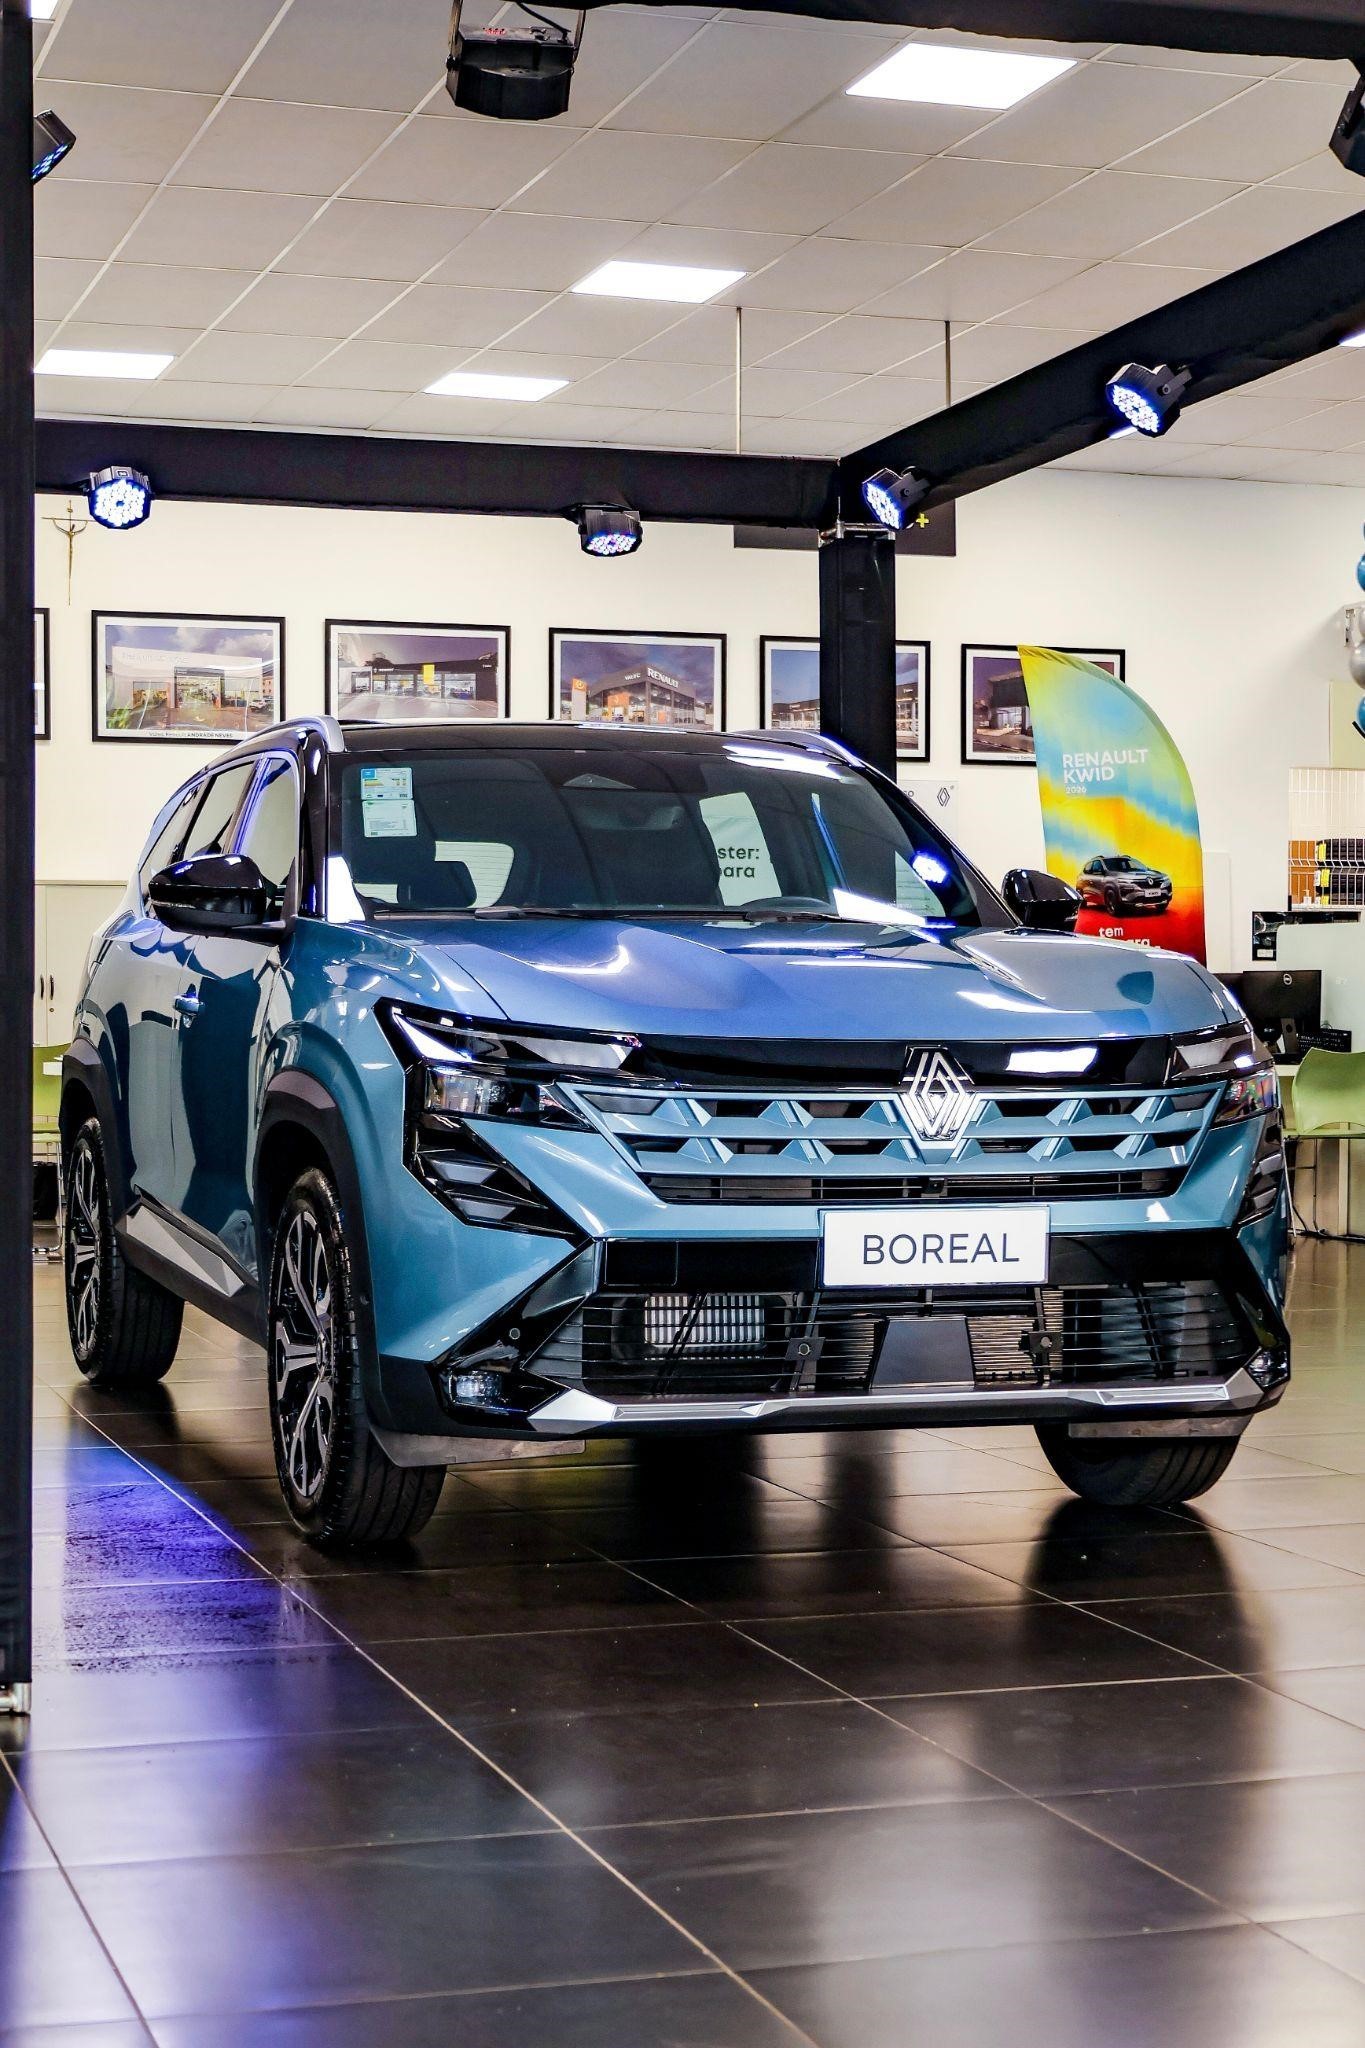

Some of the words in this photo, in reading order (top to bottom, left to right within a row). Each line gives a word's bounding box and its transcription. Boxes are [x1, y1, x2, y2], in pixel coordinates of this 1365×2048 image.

[1062, 749, 1149, 769] RENAULT
[1063, 767, 1115, 784] KWID
[1065, 785, 1087, 795] 2026
[1099, 926, 1124, 938] tem
[863, 1233, 1020, 1265] BOREAL
